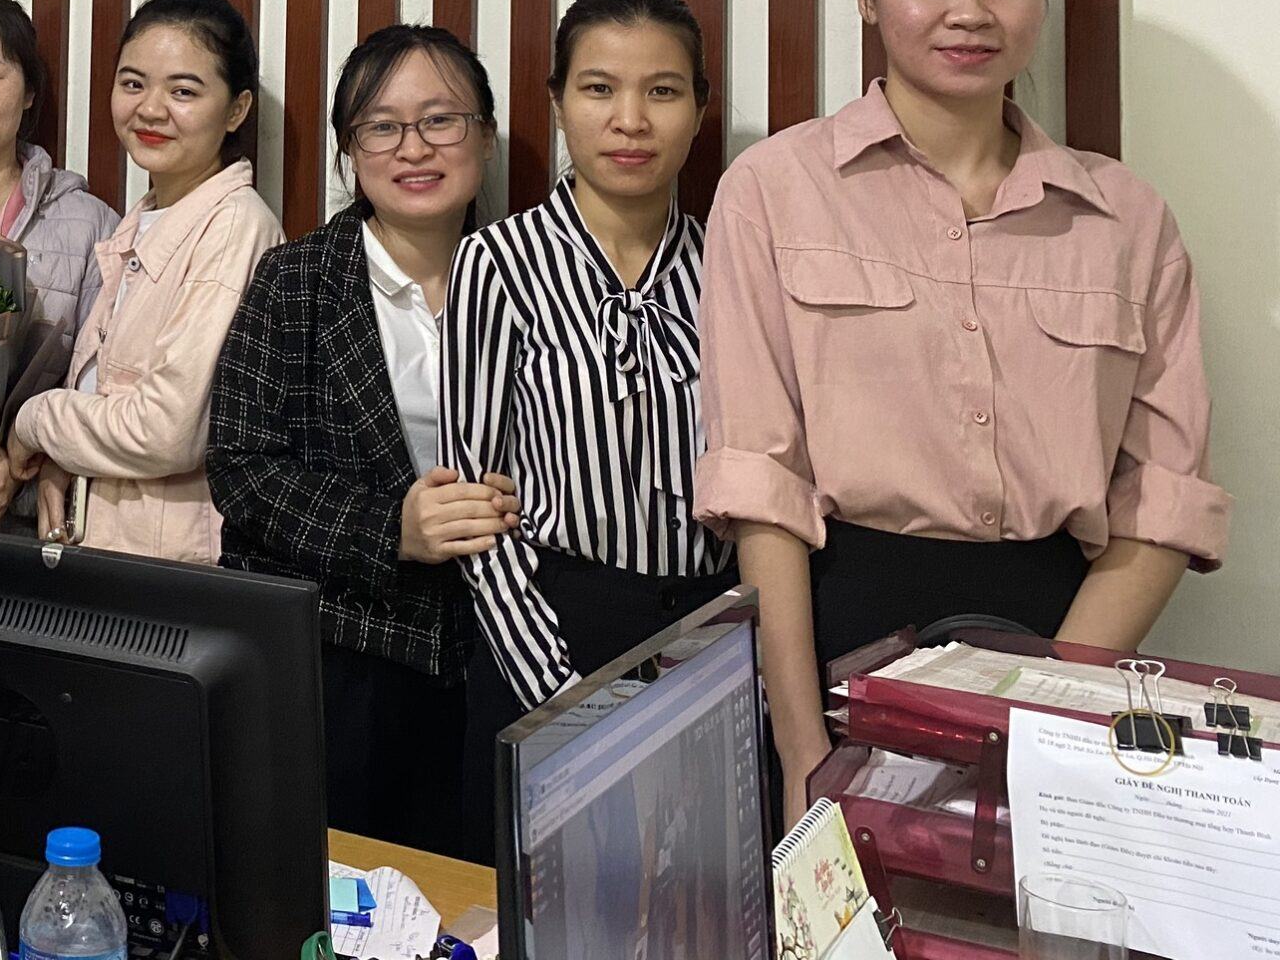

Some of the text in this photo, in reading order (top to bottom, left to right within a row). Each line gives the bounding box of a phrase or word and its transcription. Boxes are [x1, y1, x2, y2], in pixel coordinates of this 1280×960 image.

[1157, 783, 1182, 797] NGHỊ
[1184, 789, 1220, 802] THANH
[1222, 795, 1252, 808] TOÁN
